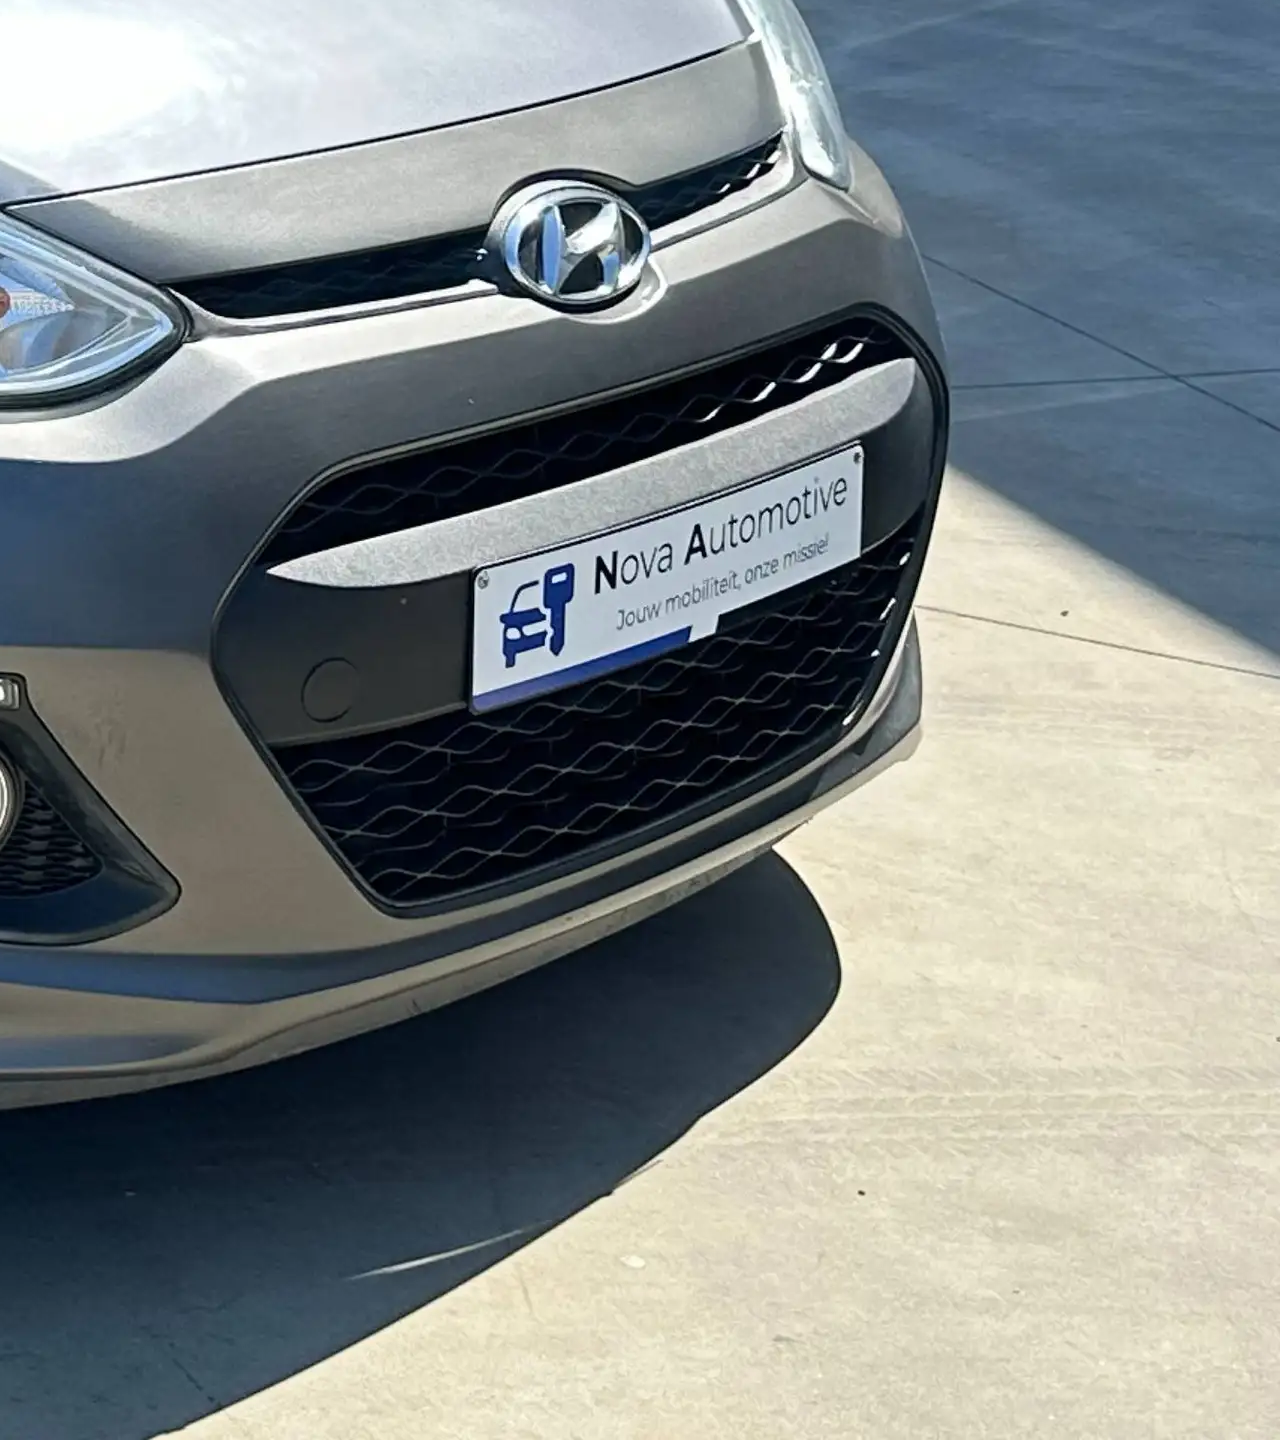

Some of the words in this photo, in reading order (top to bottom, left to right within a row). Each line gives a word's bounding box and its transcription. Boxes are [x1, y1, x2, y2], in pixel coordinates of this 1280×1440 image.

[594, 543, 673, 594] Nova
[684, 476, 848, 566] Automotive
[616, 602, 661, 631] Jouw
[665, 570, 742, 615] mobiliteit,
[744, 558, 779, 584] onze
[783, 532, 831, 571] missie!
